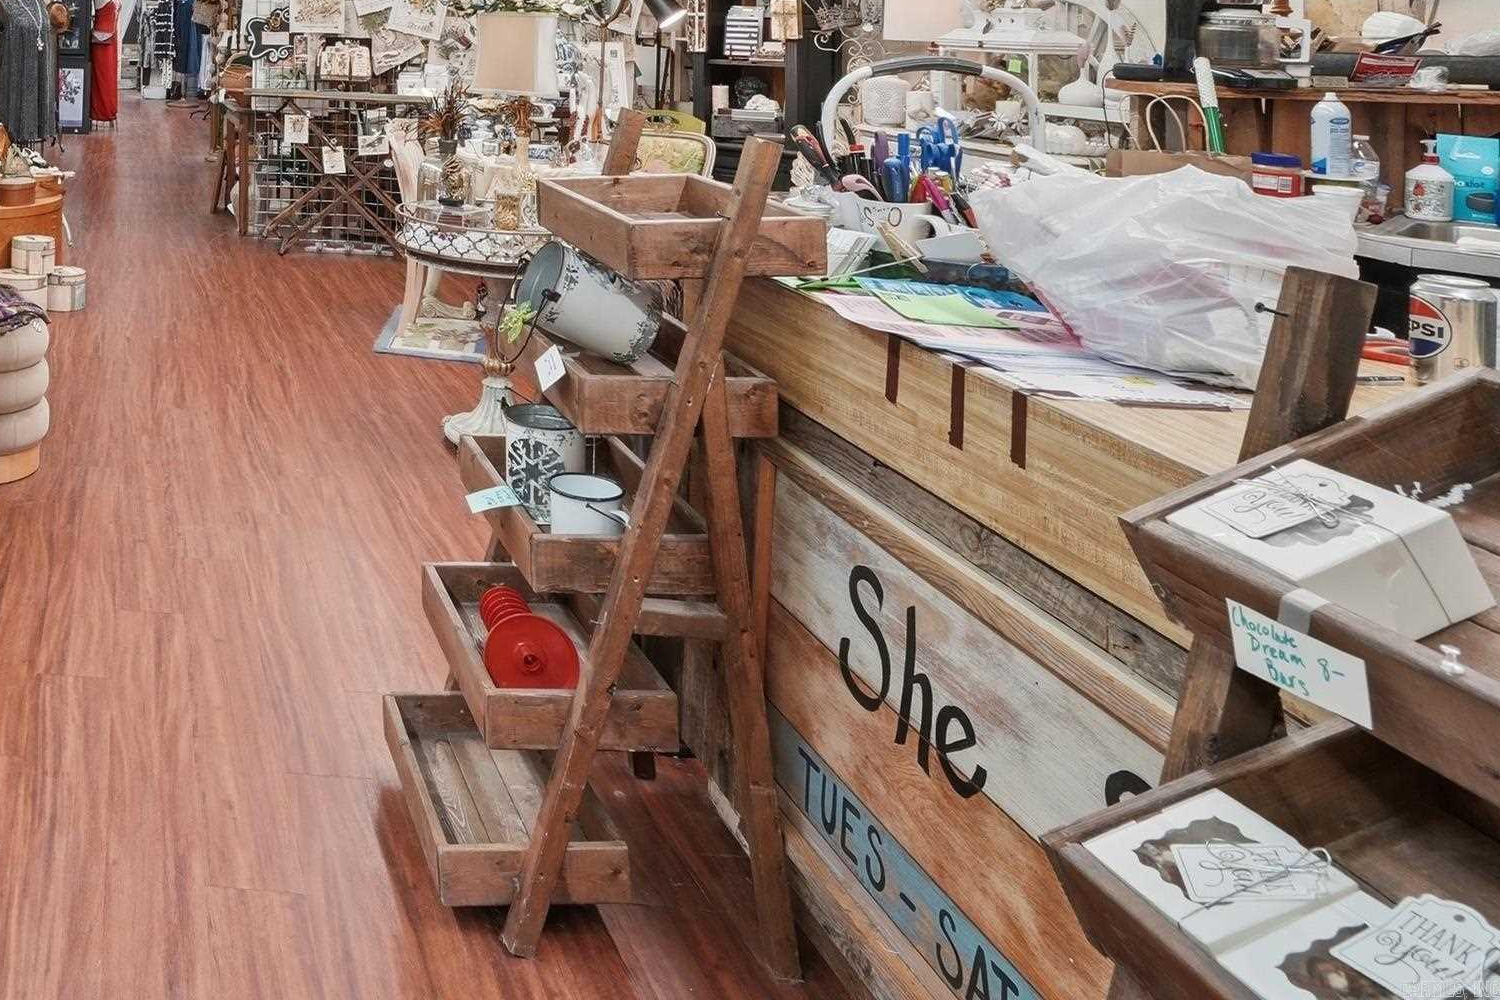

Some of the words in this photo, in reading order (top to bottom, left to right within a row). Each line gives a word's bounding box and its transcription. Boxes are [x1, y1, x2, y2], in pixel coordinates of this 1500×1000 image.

[1410, 320, 1444, 339] PSI
[1231, 604, 1298, 649] Chocolate
[1247, 632, 1307, 669] Dream
[839, 565, 988, 799] She
[1265, 657, 1310, 697] Bars
[797, 746, 887, 892] TUES
[935, 908, 1020, 1000] SAT
[1399, 910, 1481, 965] THANK
